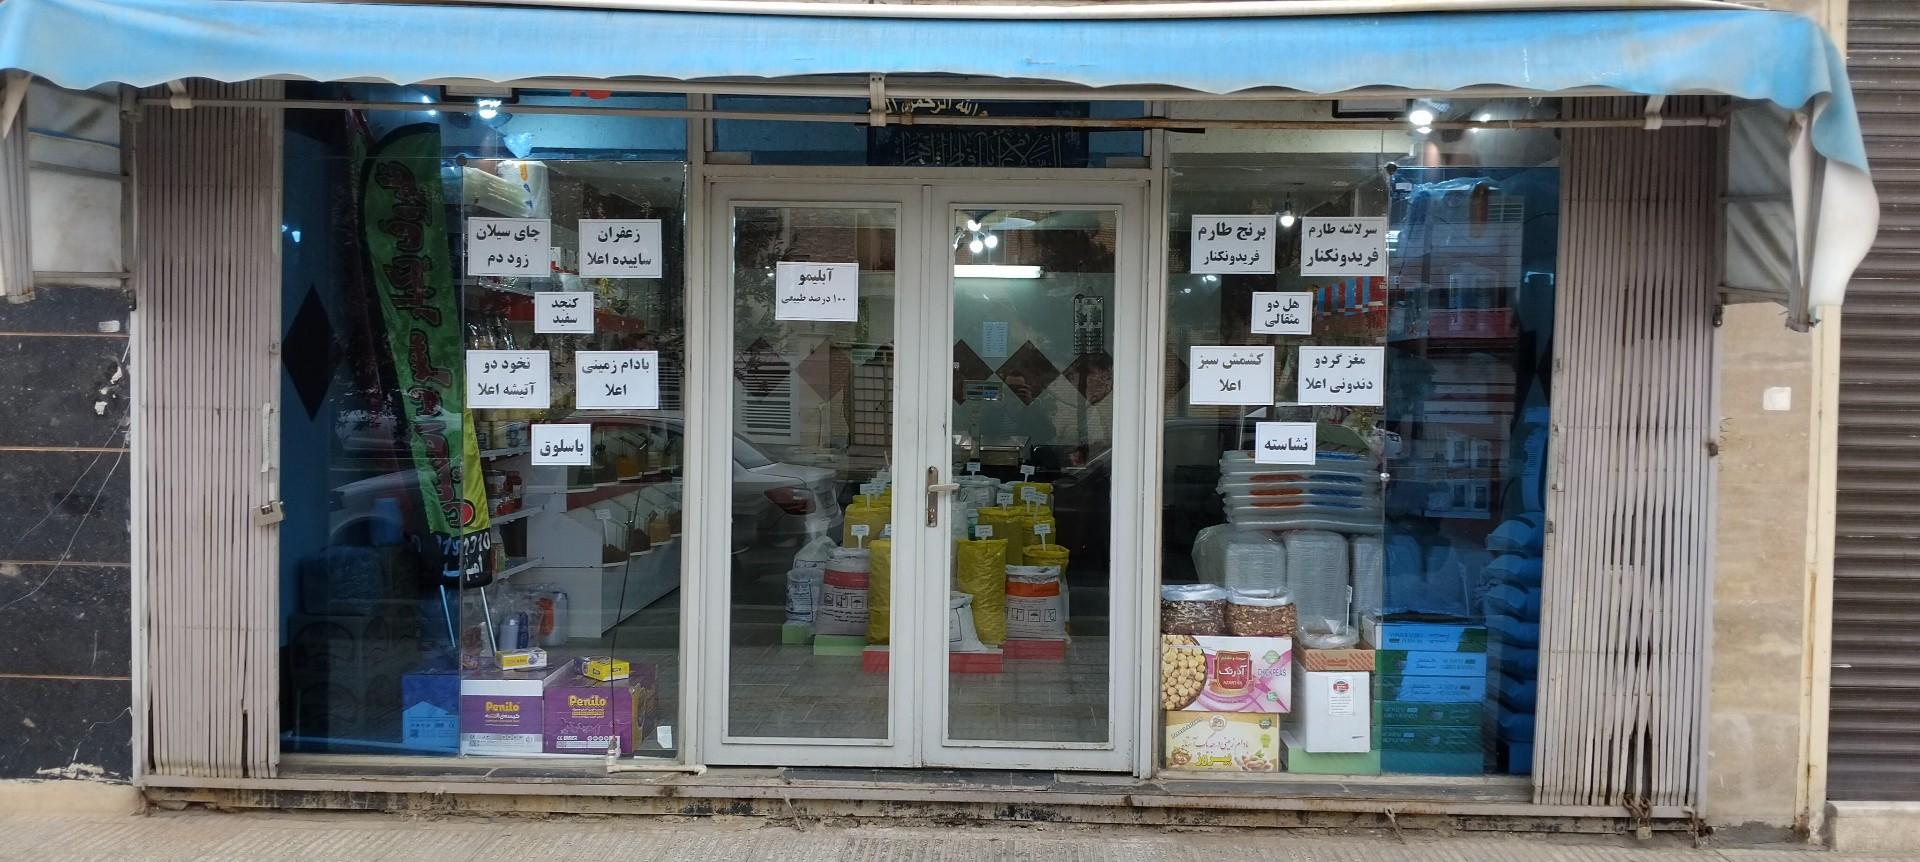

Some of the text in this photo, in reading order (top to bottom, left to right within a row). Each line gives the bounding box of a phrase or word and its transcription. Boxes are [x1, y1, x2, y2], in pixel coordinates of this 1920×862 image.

[475, 223, 542, 242] چای سیلان
[597, 225, 642, 244] زعفران
[1197, 221, 1267, 242] برنج طارم
[1307, 222, 1378, 239] سرلاشه طارم
[487, 252, 530, 269] زود دم
[586, 251, 652, 269] ساییده اعلا
[1203, 249, 1260, 266] فریدونکنار
[1305, 247, 1380, 268] فریدونکنار
[797, 267, 835, 286] آبلیمو
[382, 254, 441, 328] یکبار
[781, 292, 807, 304] طبیعی
[808, 294, 831, 305] درصد
[551, 297, 579, 311] کنجد
[1266, 297, 1300, 312] هل دو
[552, 312, 578, 327] سفید
[1264, 312, 1300, 328] مثقالی
[483, 356, 531, 374] نخود دو
[581, 357, 650, 375] بادام زمینی
[1196, 352, 1265, 370] کشمش سبز
[1313, 352, 1366, 369] مغز گردو
[477, 381, 537, 399] آتیشه اعلا
[604, 383, 627, 397] اعلا
[1218, 378, 1242, 392] اعلا
[1305, 377, 1373, 394] دندونی اعلا
[539, 438, 585, 457] باسلوق
[1263, 437, 1309, 451] نشاسته
[485, 701, 520, 712] Penilo
[569, 694, 607, 707] Penilo
[1195, 752, 1233, 767] پیروز
